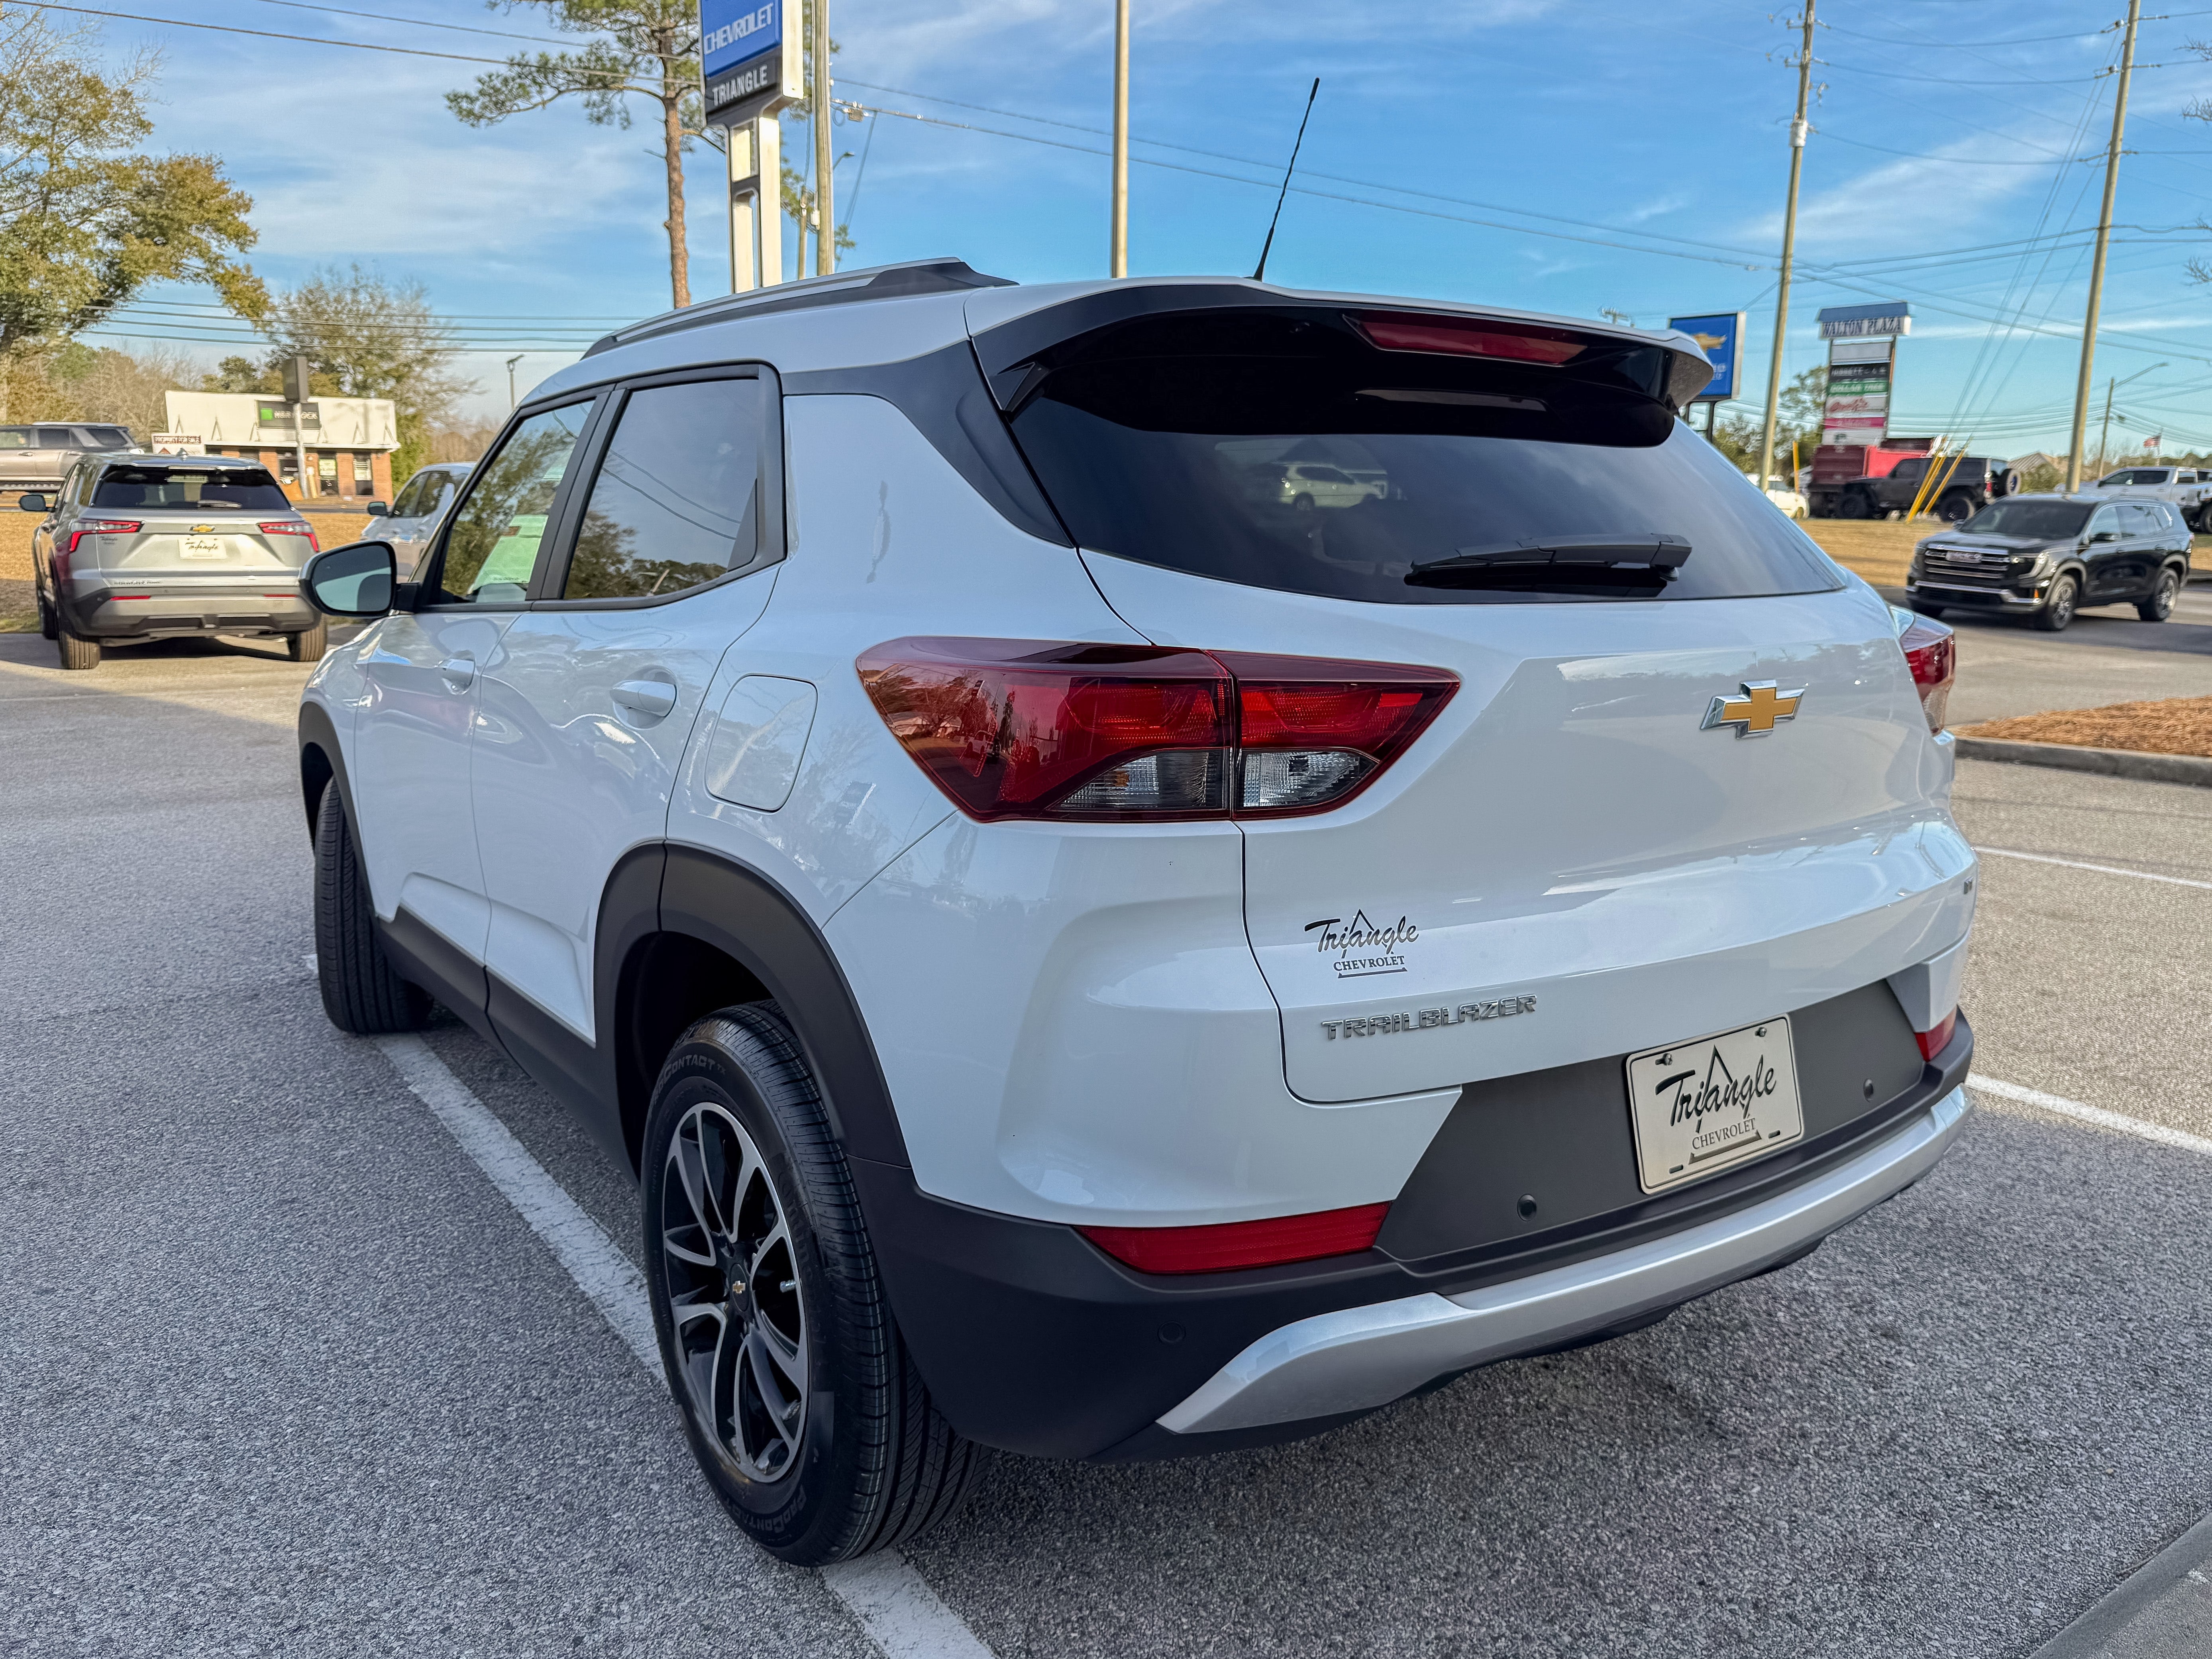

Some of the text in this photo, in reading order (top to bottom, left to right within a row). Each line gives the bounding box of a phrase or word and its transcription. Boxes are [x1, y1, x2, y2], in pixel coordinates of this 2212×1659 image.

[704, 2, 773, 55] CHEVROLET
[712, 65, 768, 106] TRIANGLE
[1823, 316, 1901, 337] WALTON PLAZA
[1305, 913, 1419, 955] Triangle
[1333, 955, 1405, 972] CHEVROLET
[1321, 994, 1537, 1040] TRAILBLAZER
[1655, 1054, 1776, 1127] Triangle
[1692, 1117, 1756, 1150] CHEVROLET
